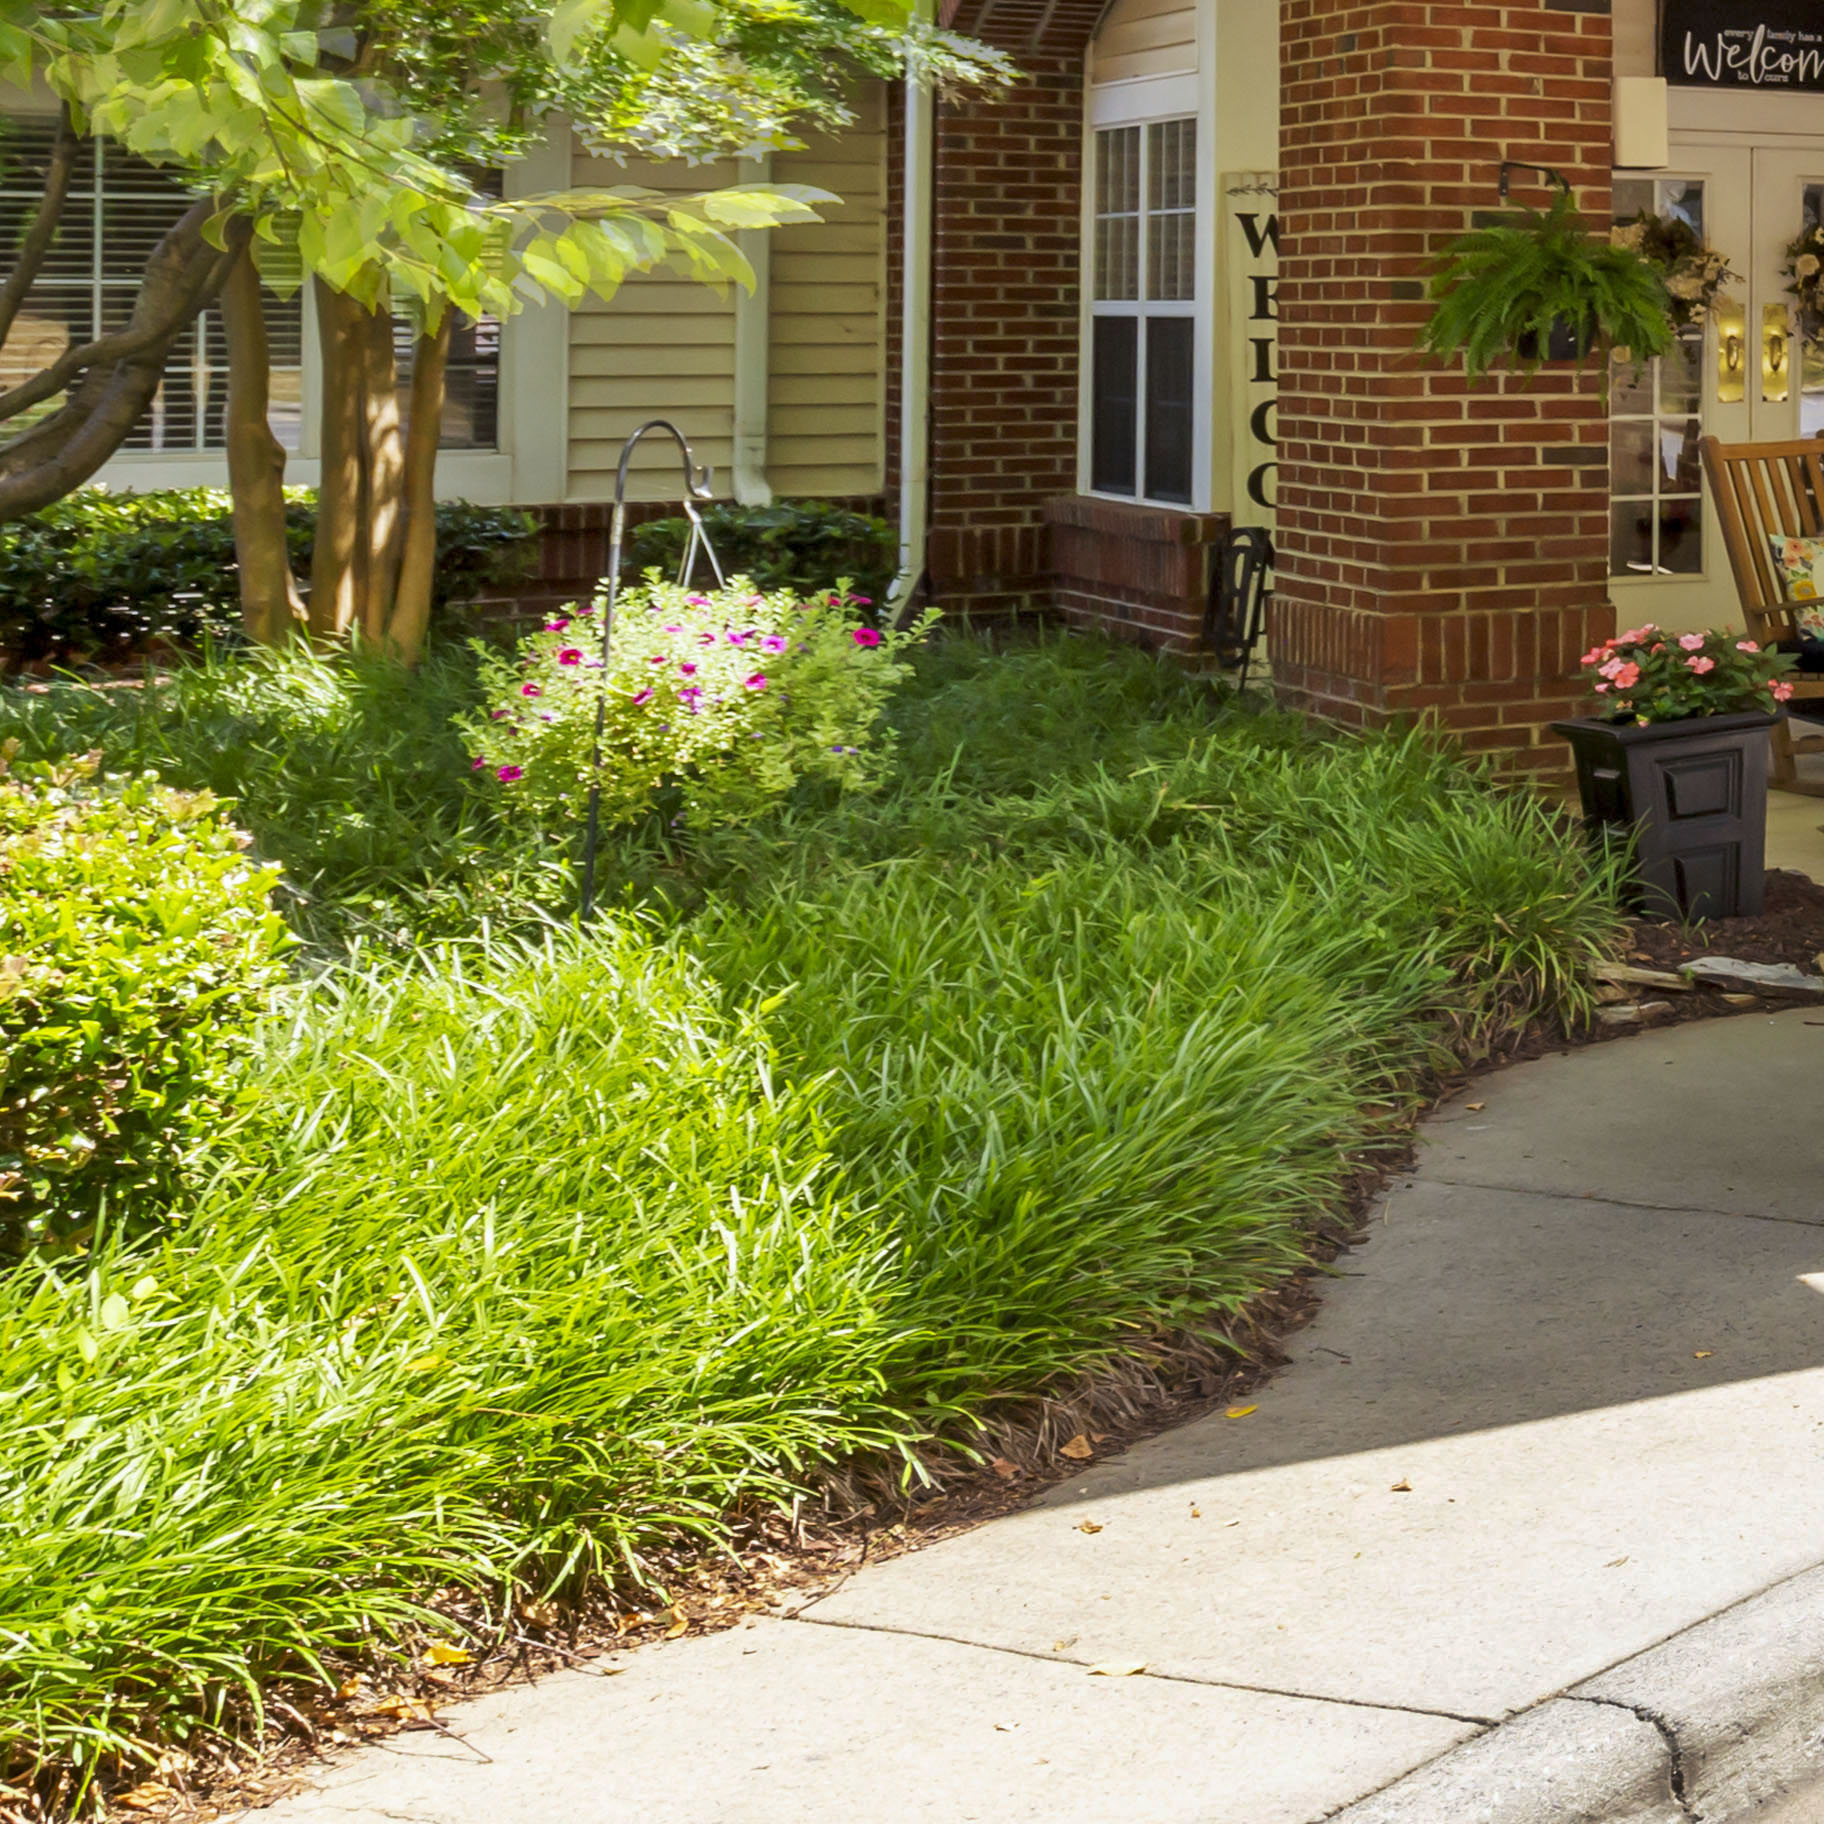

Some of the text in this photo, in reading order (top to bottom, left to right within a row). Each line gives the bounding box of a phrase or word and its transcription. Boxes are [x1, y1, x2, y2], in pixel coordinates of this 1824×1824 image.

[1723, 29, 1754, 41] every
[1798, 31, 1815, 42] has
[1737, 70, 1749, 81] to
[1234, 212, 1279, 509] WELCO
